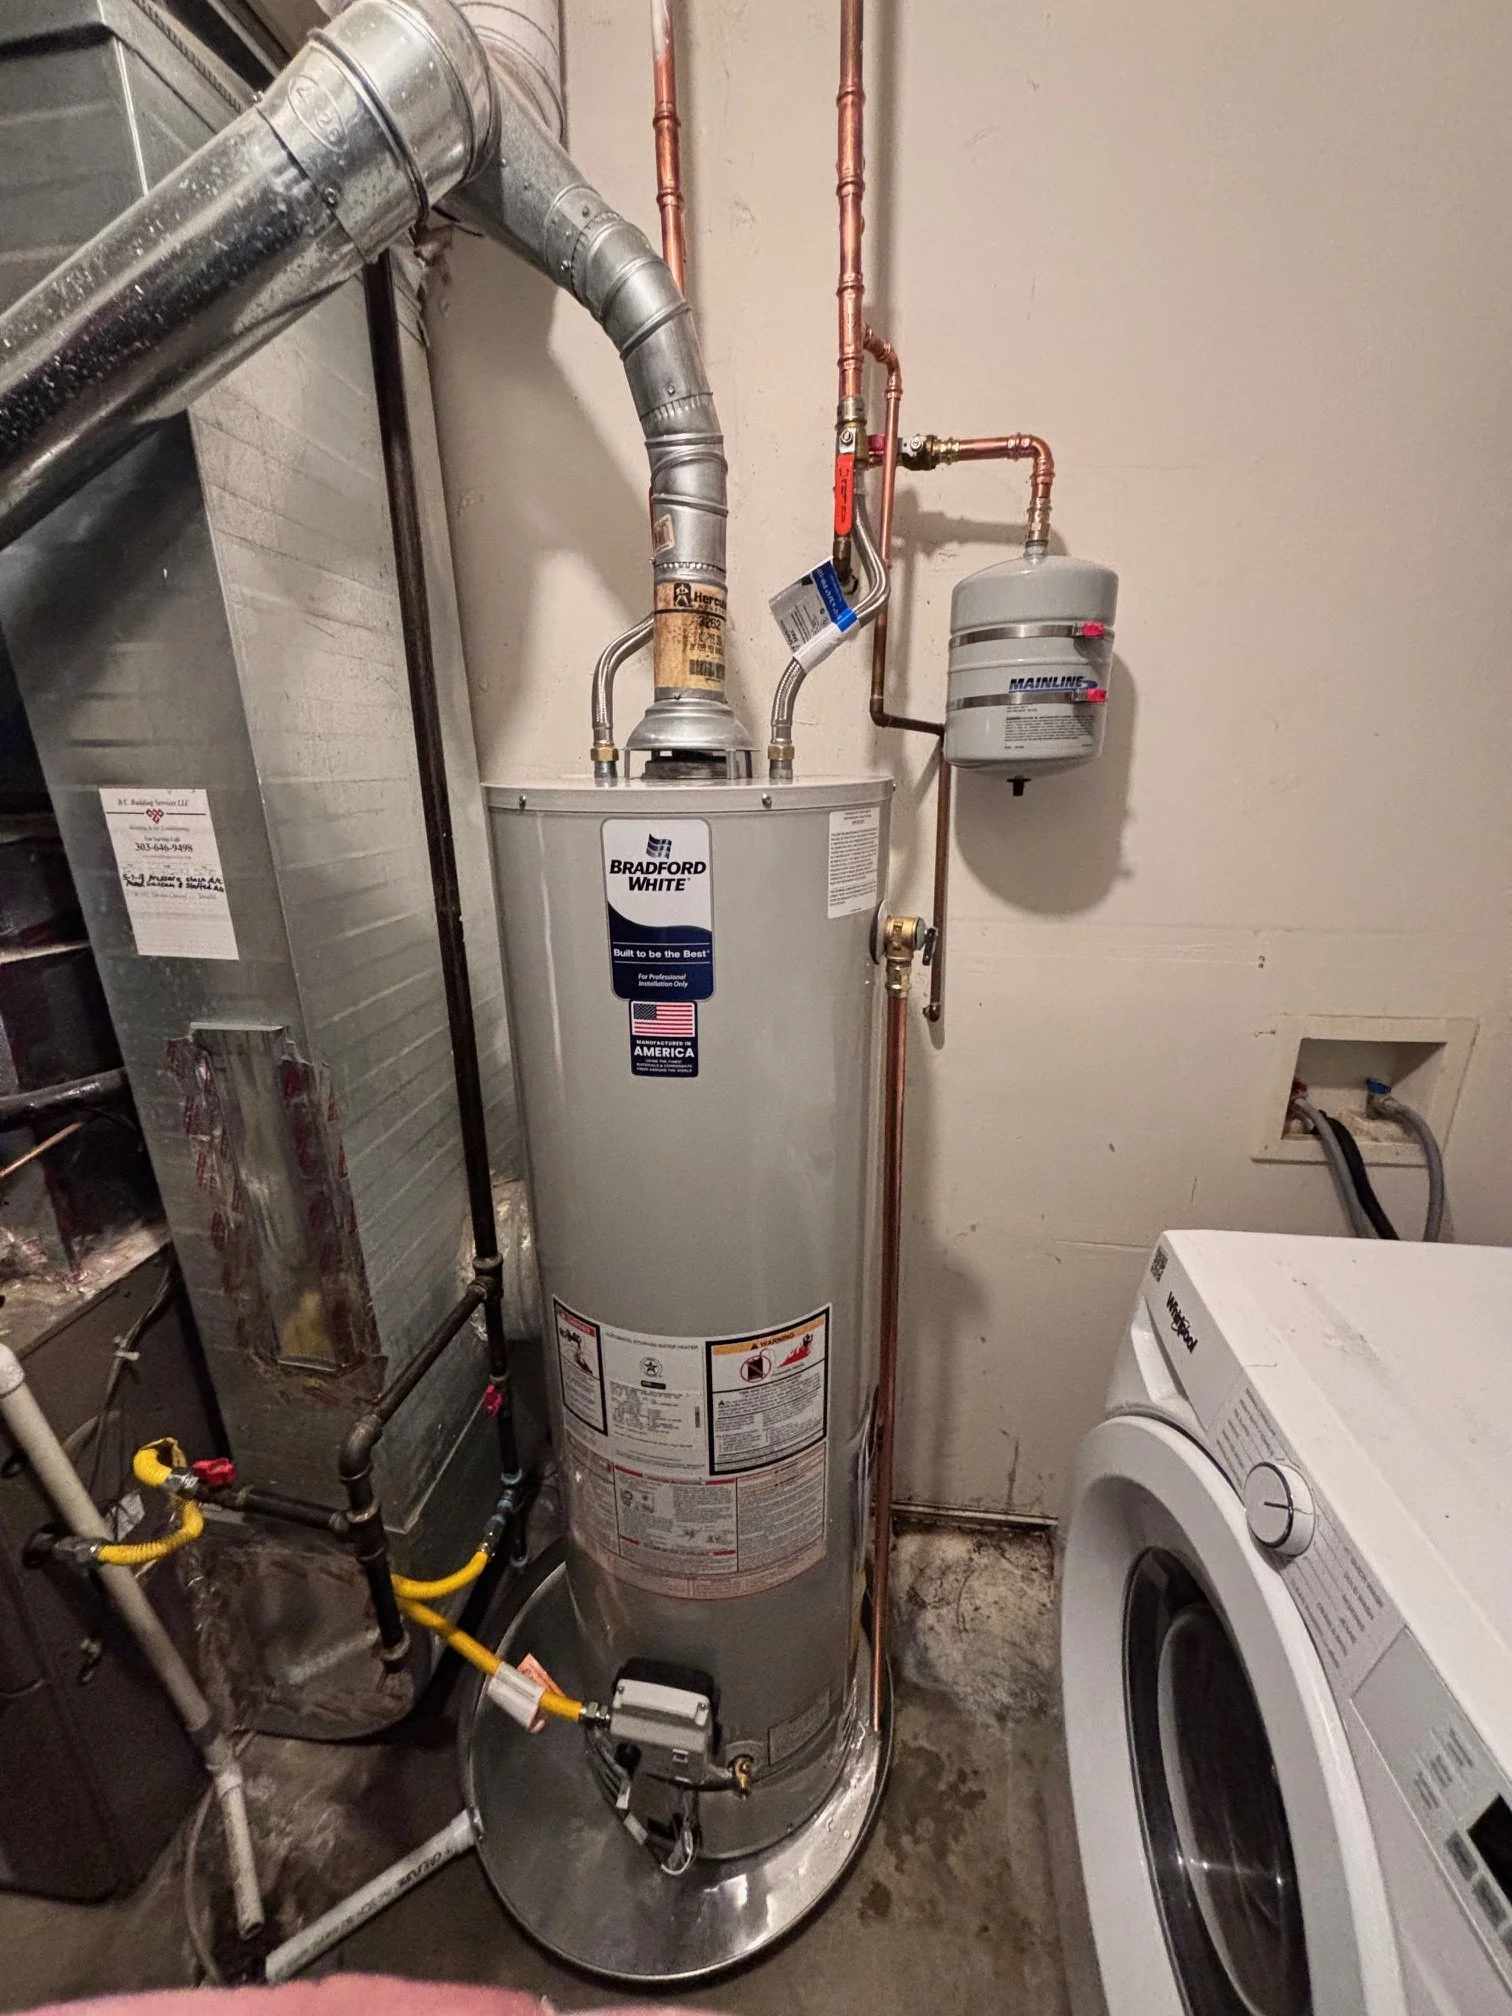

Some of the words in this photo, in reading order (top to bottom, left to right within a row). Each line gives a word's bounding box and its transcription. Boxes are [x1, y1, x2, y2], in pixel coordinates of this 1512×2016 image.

[1009, 676, 1085, 690] MAINLINE
[609, 859, 707, 875] BRADFORD
[628, 876, 687, 892] WHITE
[613, 949, 634, 958] Built
[636, 950, 646, 958] to
[648, 950, 661, 958] be
[664, 950, 681, 958] the
[683, 950, 707, 958] Best
[634, 1046, 695, 1058] AMERICA
[1166, 1291, 1198, 1354] Whirlpool
[760, 1332, 795, 1347] WARNING
